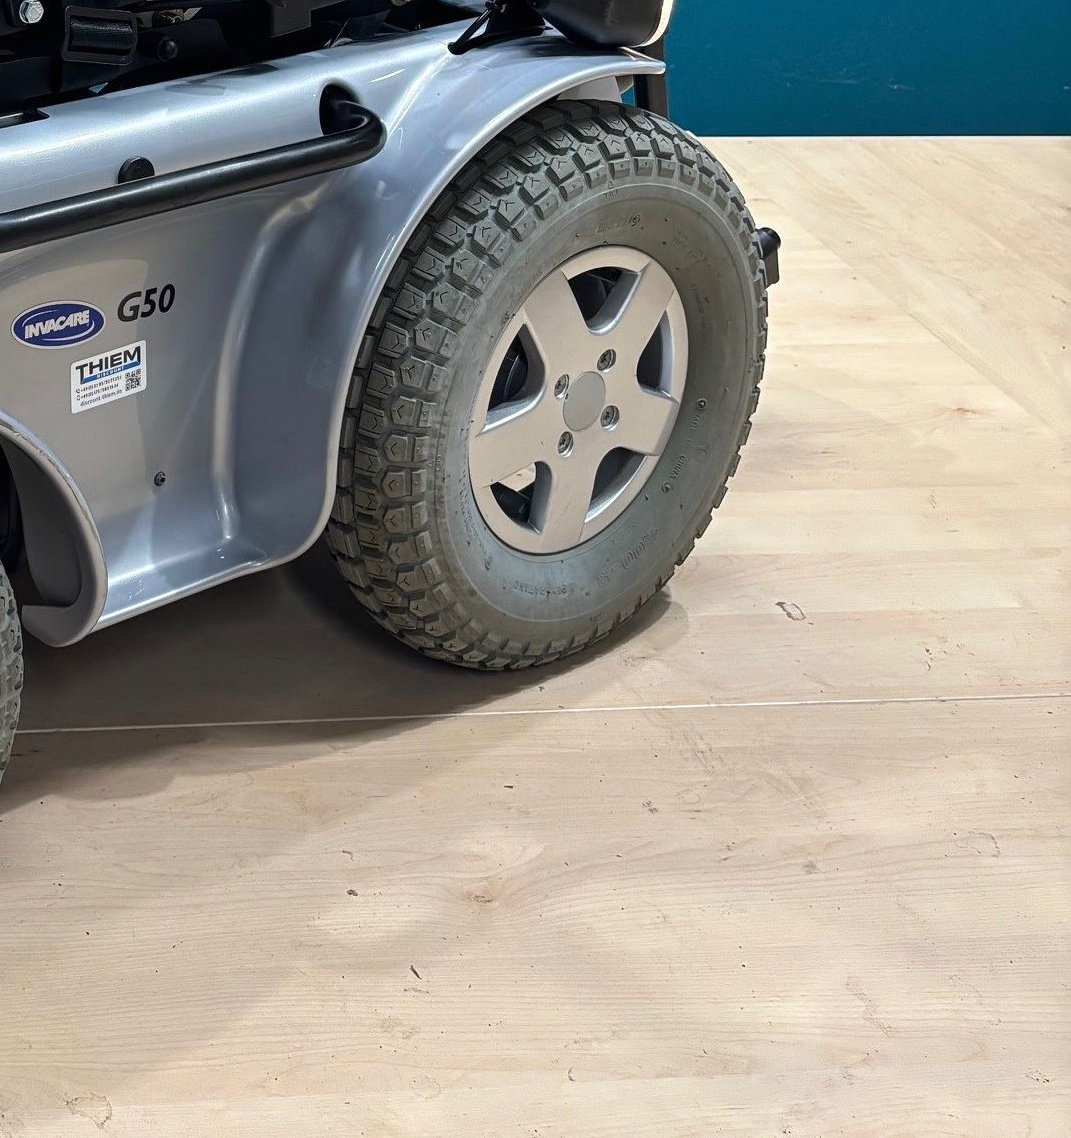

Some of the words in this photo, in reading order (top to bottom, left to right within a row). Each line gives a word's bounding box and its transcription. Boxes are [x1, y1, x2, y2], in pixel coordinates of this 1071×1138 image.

[117, 283, 176, 322] G50
[24, 309, 90, 340] INVACARE
[75, 345, 141, 383] THIEM
